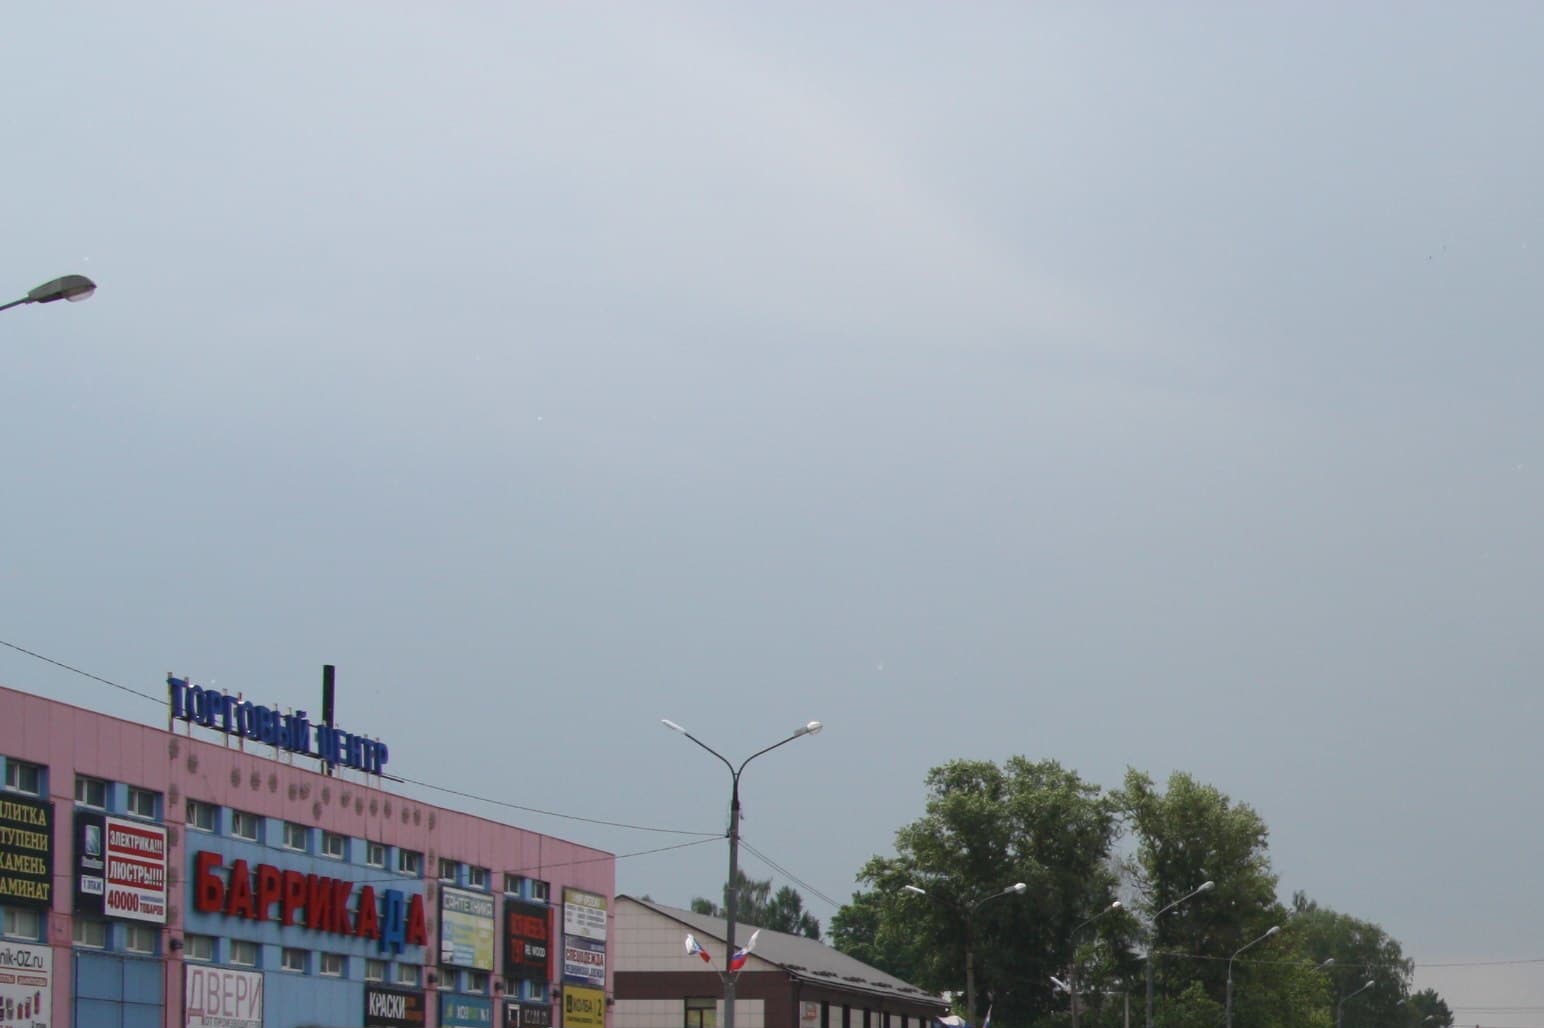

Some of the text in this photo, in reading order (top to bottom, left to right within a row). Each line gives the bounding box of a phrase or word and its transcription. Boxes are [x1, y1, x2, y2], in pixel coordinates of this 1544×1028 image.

[167, 677, 389, 776] ТОРГОВЫЙ ЦЕНТР
[108, 889, 139, 911] 40000
[194, 849, 428, 954] БАРРИКАДА
[187, 969, 262, 1025] ДВЕРИ
[369, 991, 405, 1020] КРАСКИ
